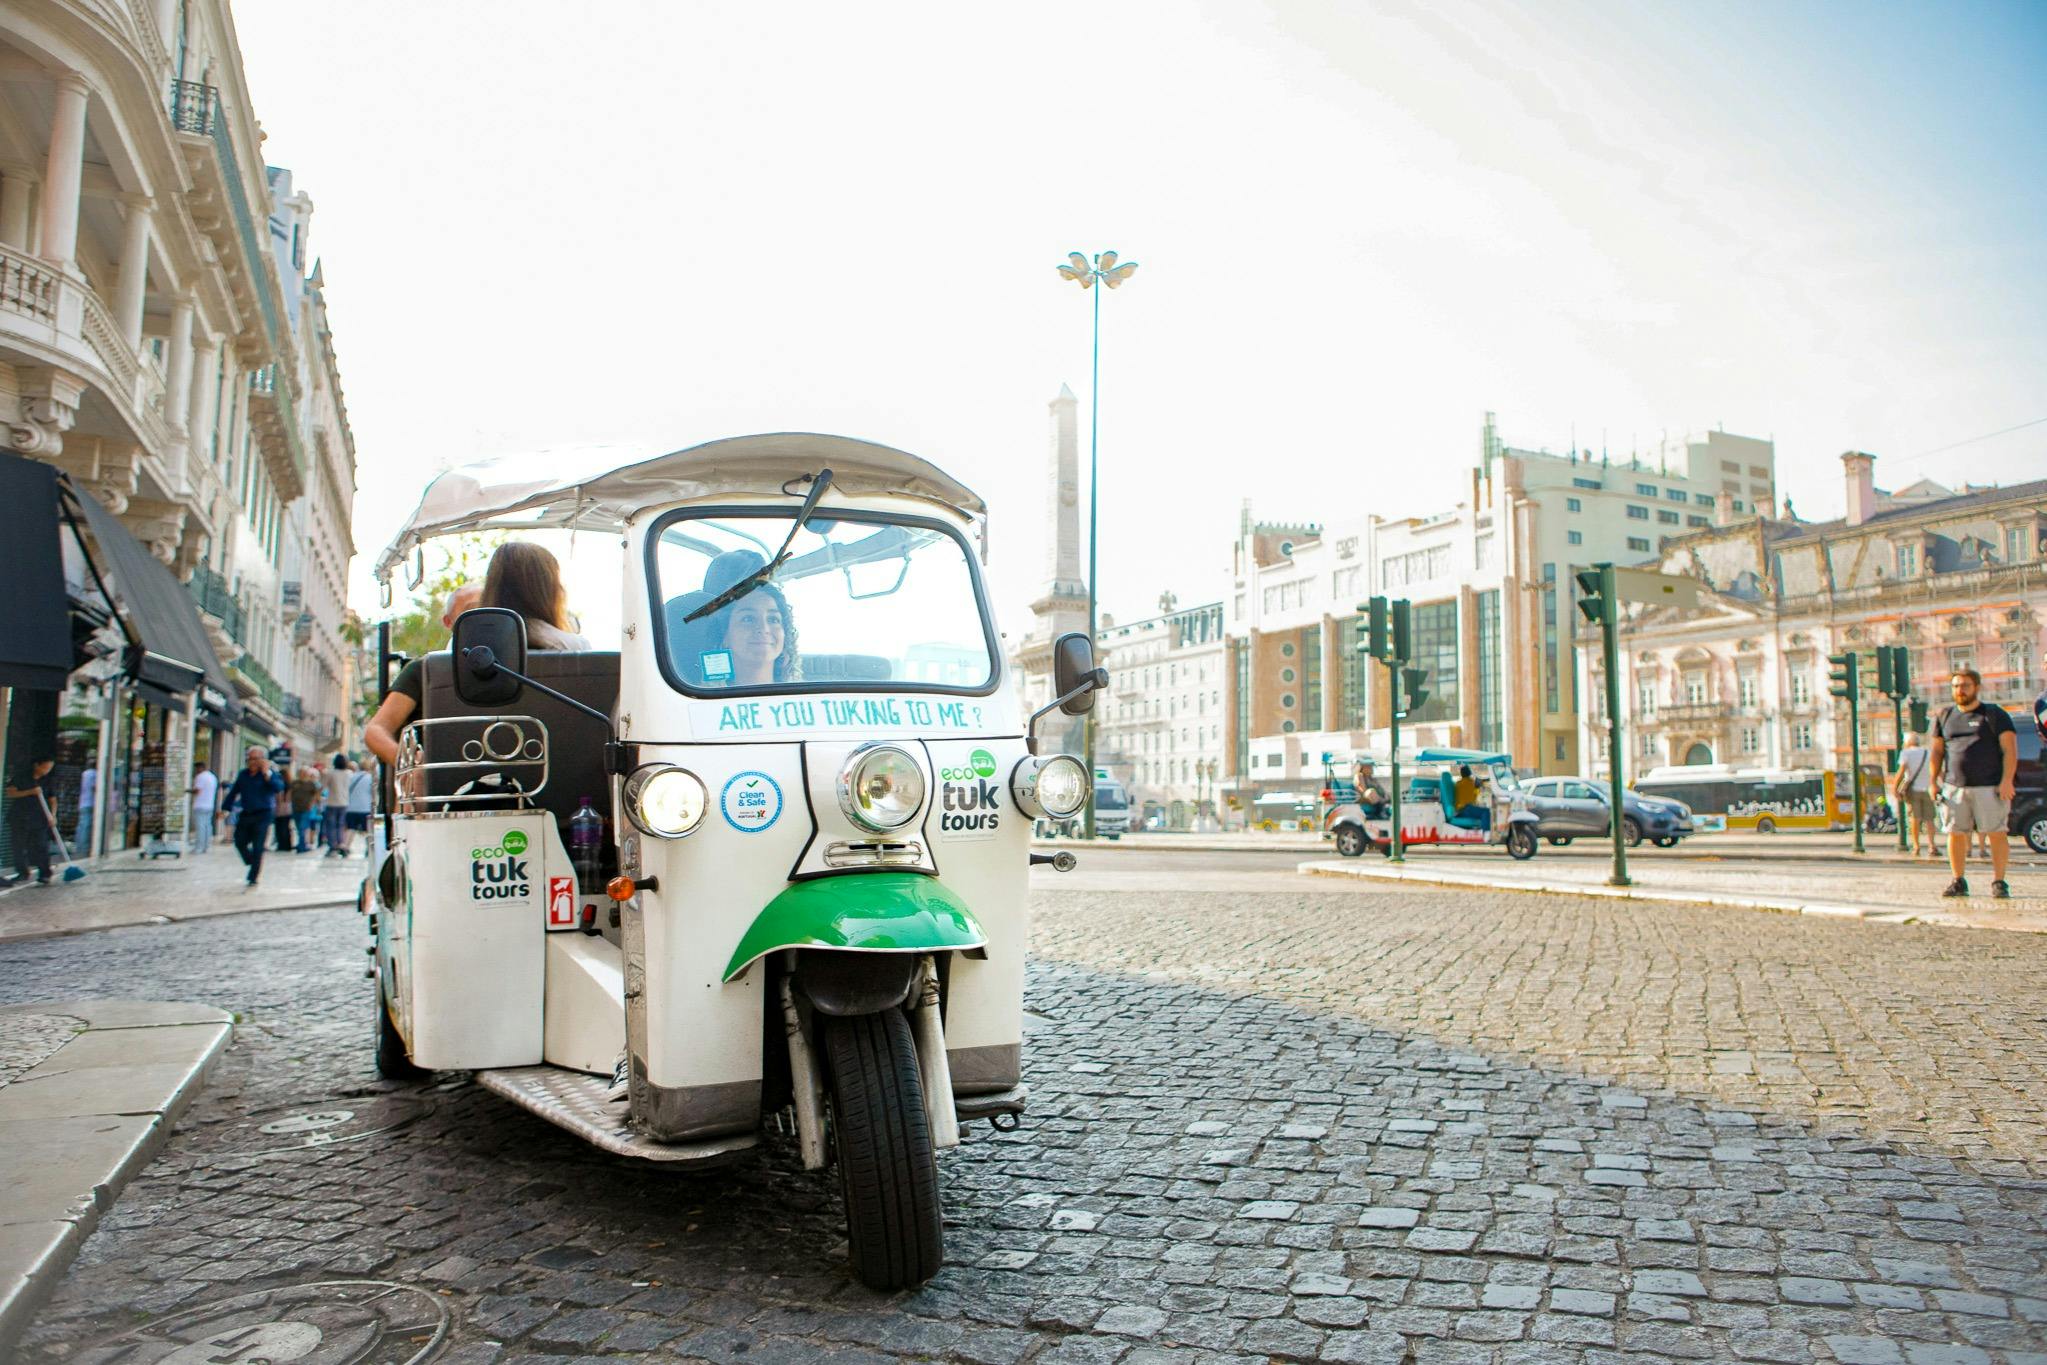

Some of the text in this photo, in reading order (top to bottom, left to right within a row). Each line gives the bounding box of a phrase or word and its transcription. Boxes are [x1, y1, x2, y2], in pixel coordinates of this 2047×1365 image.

[719, 702, 763, 731] ARE
[769, 701, 816, 727] YOU
[821, 698, 901, 726] TUKING
[904, 700, 933, 726] TO
[937, 702, 969, 727] ME
[941, 767, 974, 780] eco
[738, 798, 767, 807] & Safe
[739, 791, 765, 799] Clean
[943, 778, 1000, 811] tuk
[941, 812, 999, 831] tours
[471, 847, 504, 859] eco
[472, 856, 529, 884] tuk
[472, 884, 530, 900] tours
